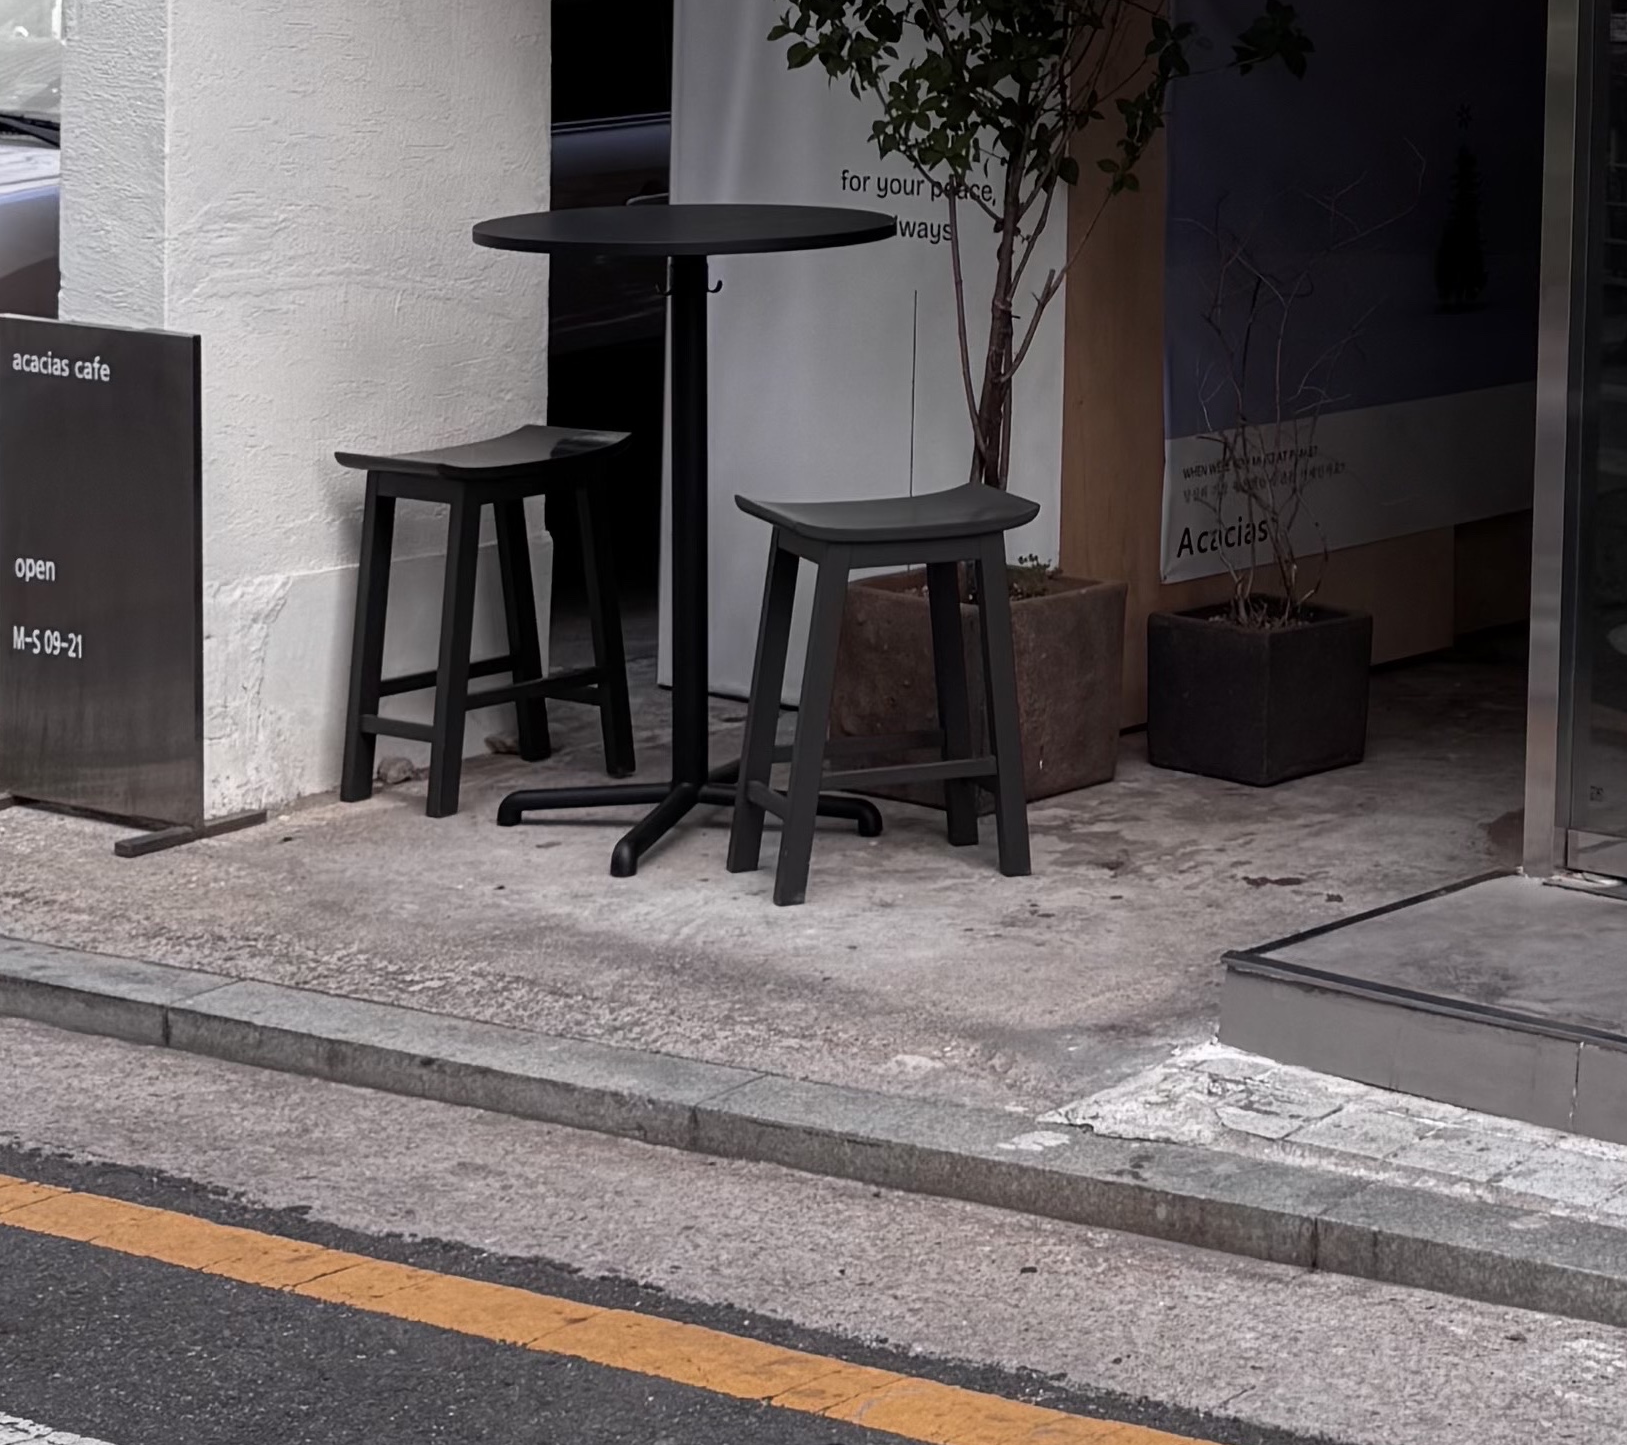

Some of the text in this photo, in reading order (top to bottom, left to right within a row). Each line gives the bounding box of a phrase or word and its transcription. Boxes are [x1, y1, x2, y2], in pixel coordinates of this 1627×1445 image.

[842, 169, 871, 193] for
[877, 176, 925, 199] your
[895, 215, 953, 245] lways
[12, 351, 111, 382] acacias cafe
[1177, 516, 1268, 558] Acacias
[15, 557, 56, 582] open
[13, 625, 82, 659] M-S 09-21
